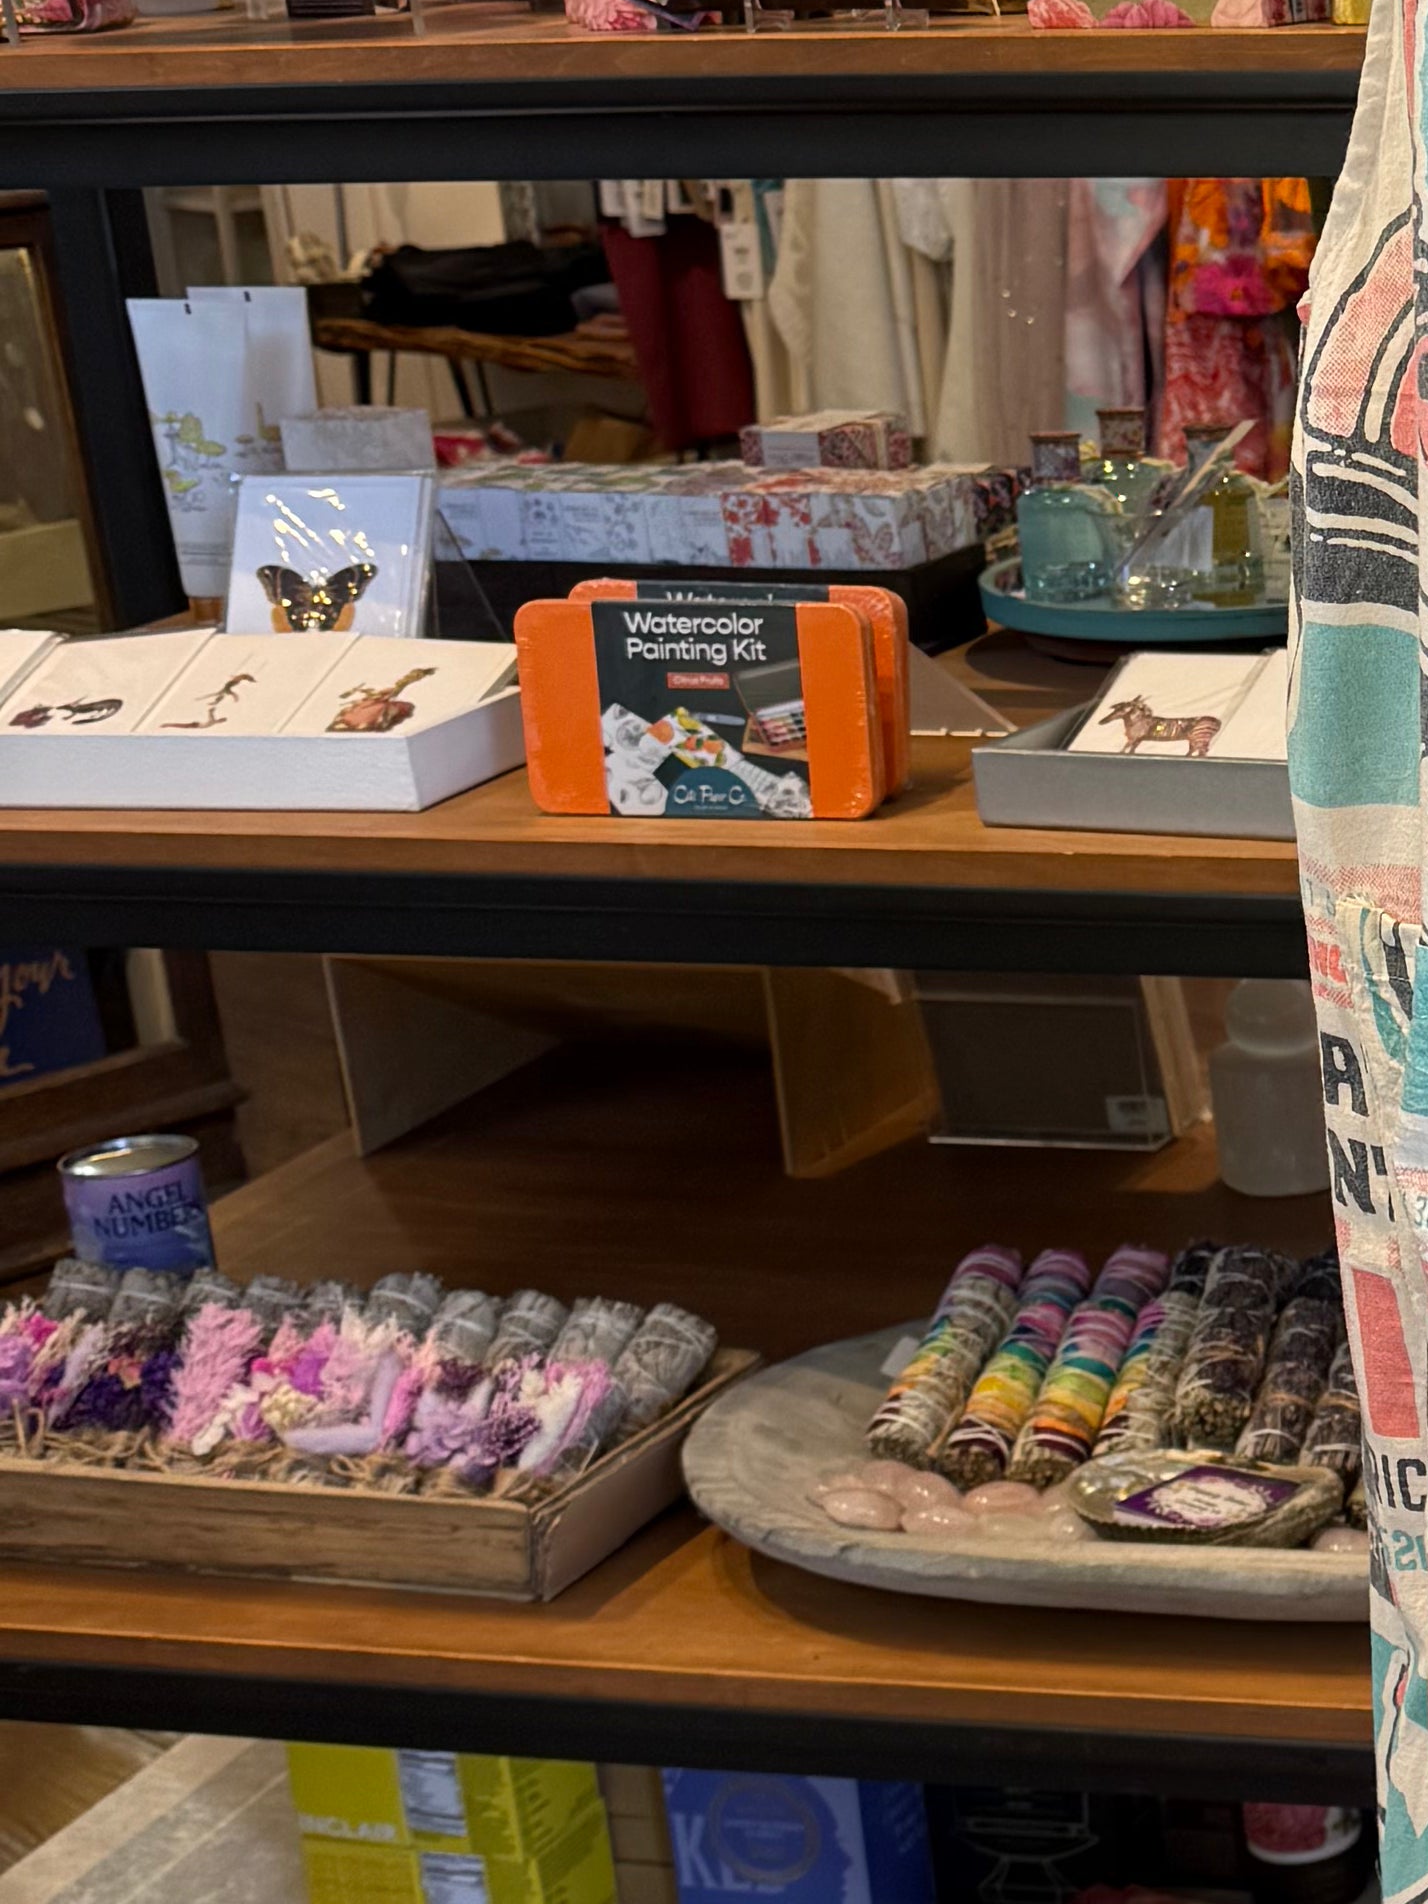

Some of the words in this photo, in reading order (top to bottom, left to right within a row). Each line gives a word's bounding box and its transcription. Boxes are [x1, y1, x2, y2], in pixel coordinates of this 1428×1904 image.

[624, 611, 764, 636] Watercolor
[626, 637, 728, 666] Painting
[733, 639, 768, 662] Kit
[93, 1204, 190, 1239] NUMBE
